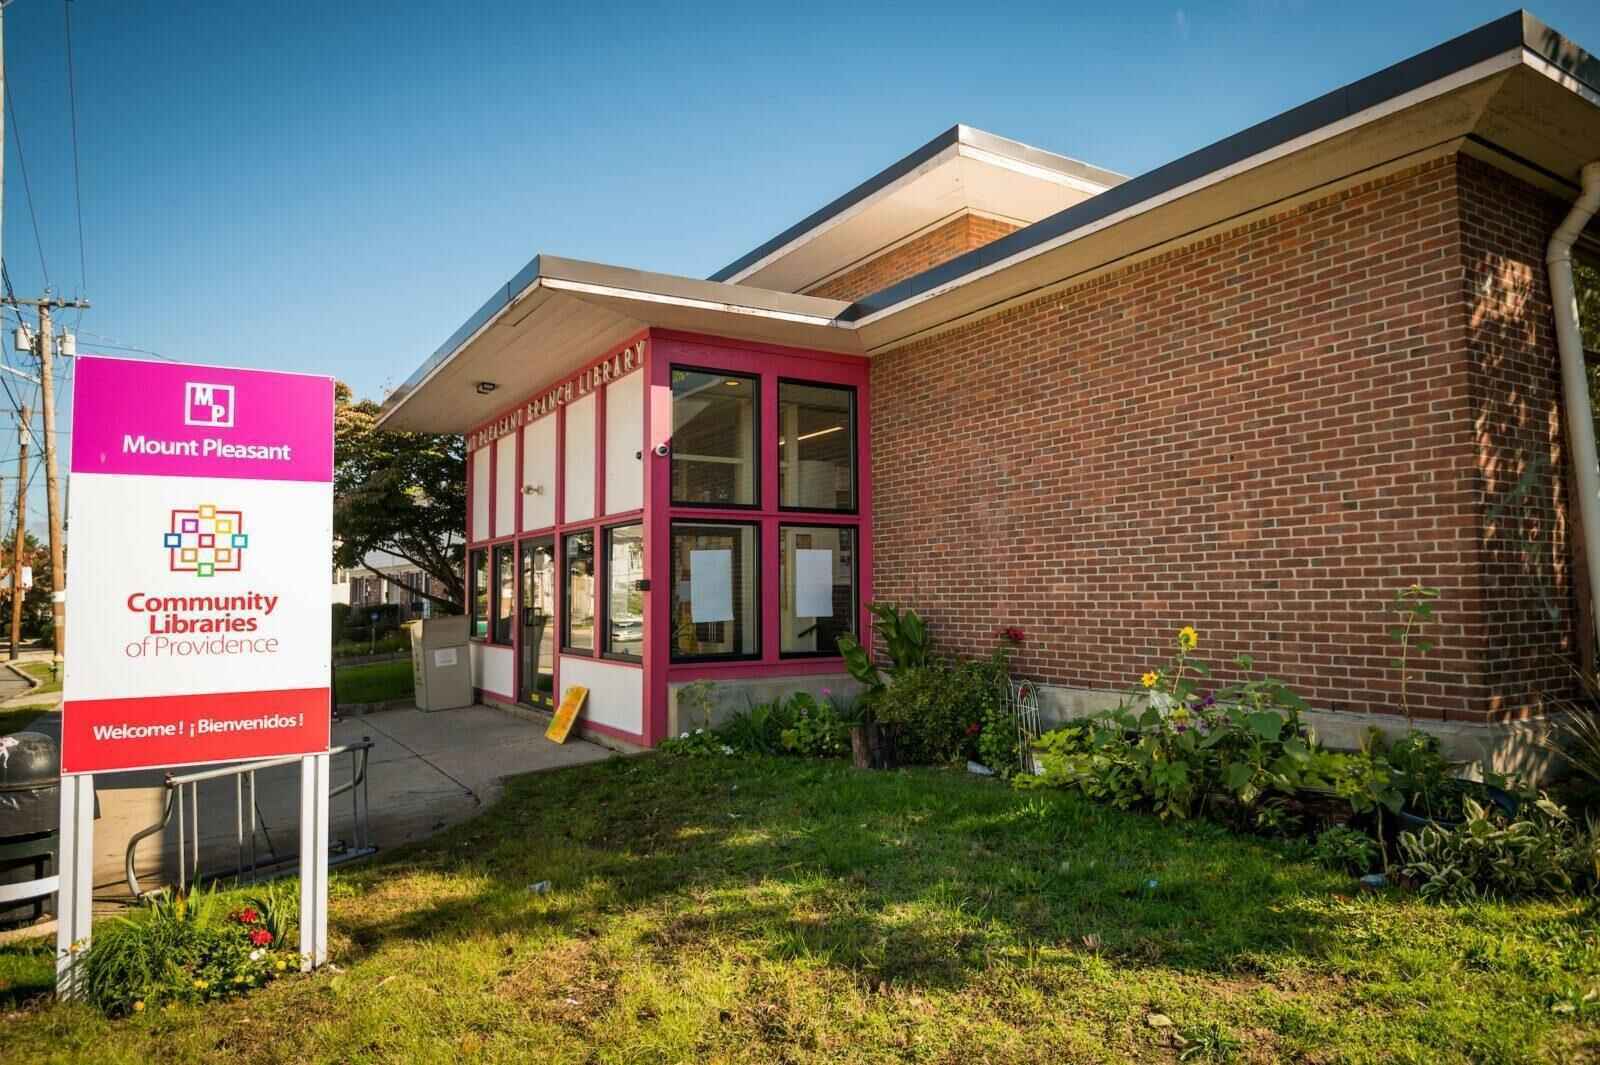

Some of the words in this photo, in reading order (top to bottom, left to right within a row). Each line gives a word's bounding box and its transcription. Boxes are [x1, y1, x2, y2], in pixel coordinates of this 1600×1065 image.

[527, 381, 573, 422] BRANCH
[579, 340, 646, 394] LIBRARY
[122, 434, 198, 457] Mount
[202, 438, 291, 461] Pleasant
[127, 591, 279, 617] Community
[149, 613, 258, 635] Libraries
[125, 636, 151, 658] of
[155, 634, 279, 656] Providence
[93, 721, 184, 741] Welcome!
